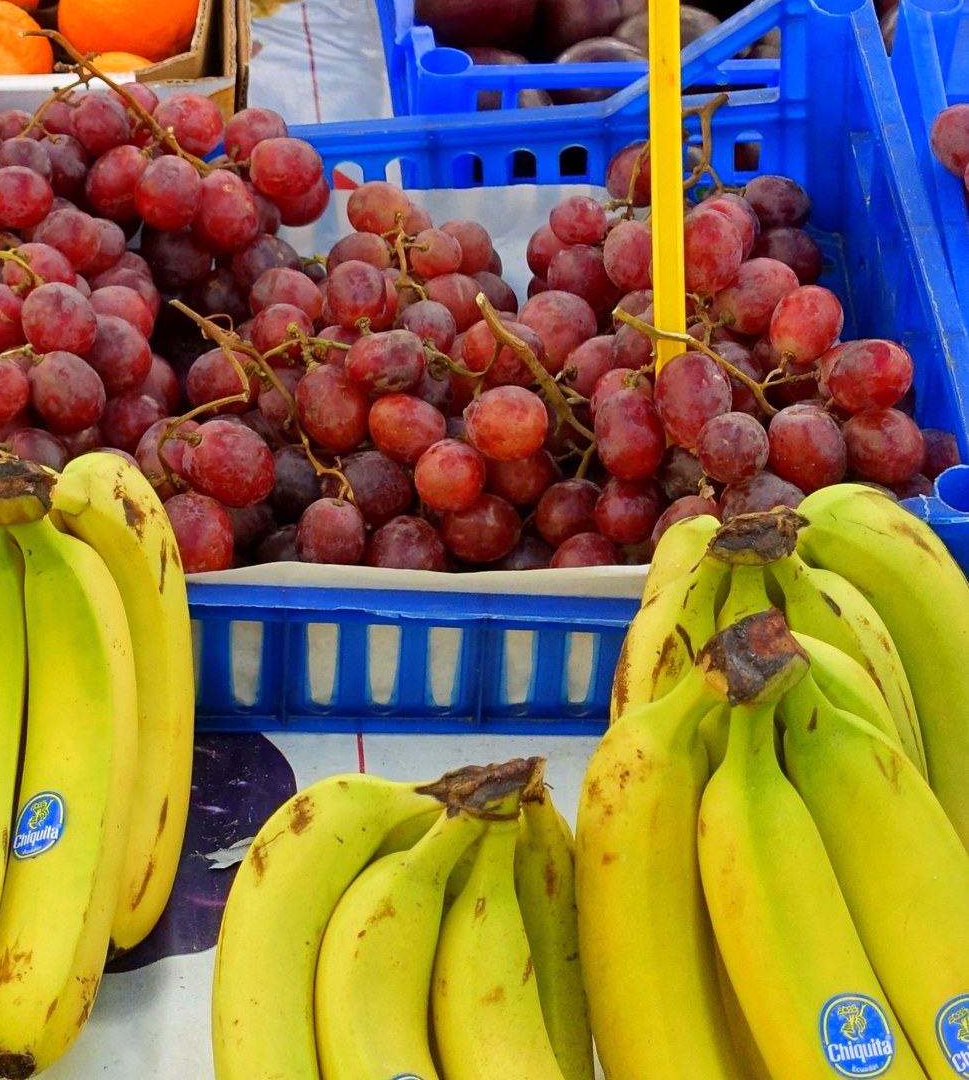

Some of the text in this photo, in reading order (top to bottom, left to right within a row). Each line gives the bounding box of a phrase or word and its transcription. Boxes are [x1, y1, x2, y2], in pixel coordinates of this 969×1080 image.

[13, 824, 59, 849] Chiquita
[827, 1038, 893, 1063] Chiquita
[851, 1063, 878, 1073] Ecuador
